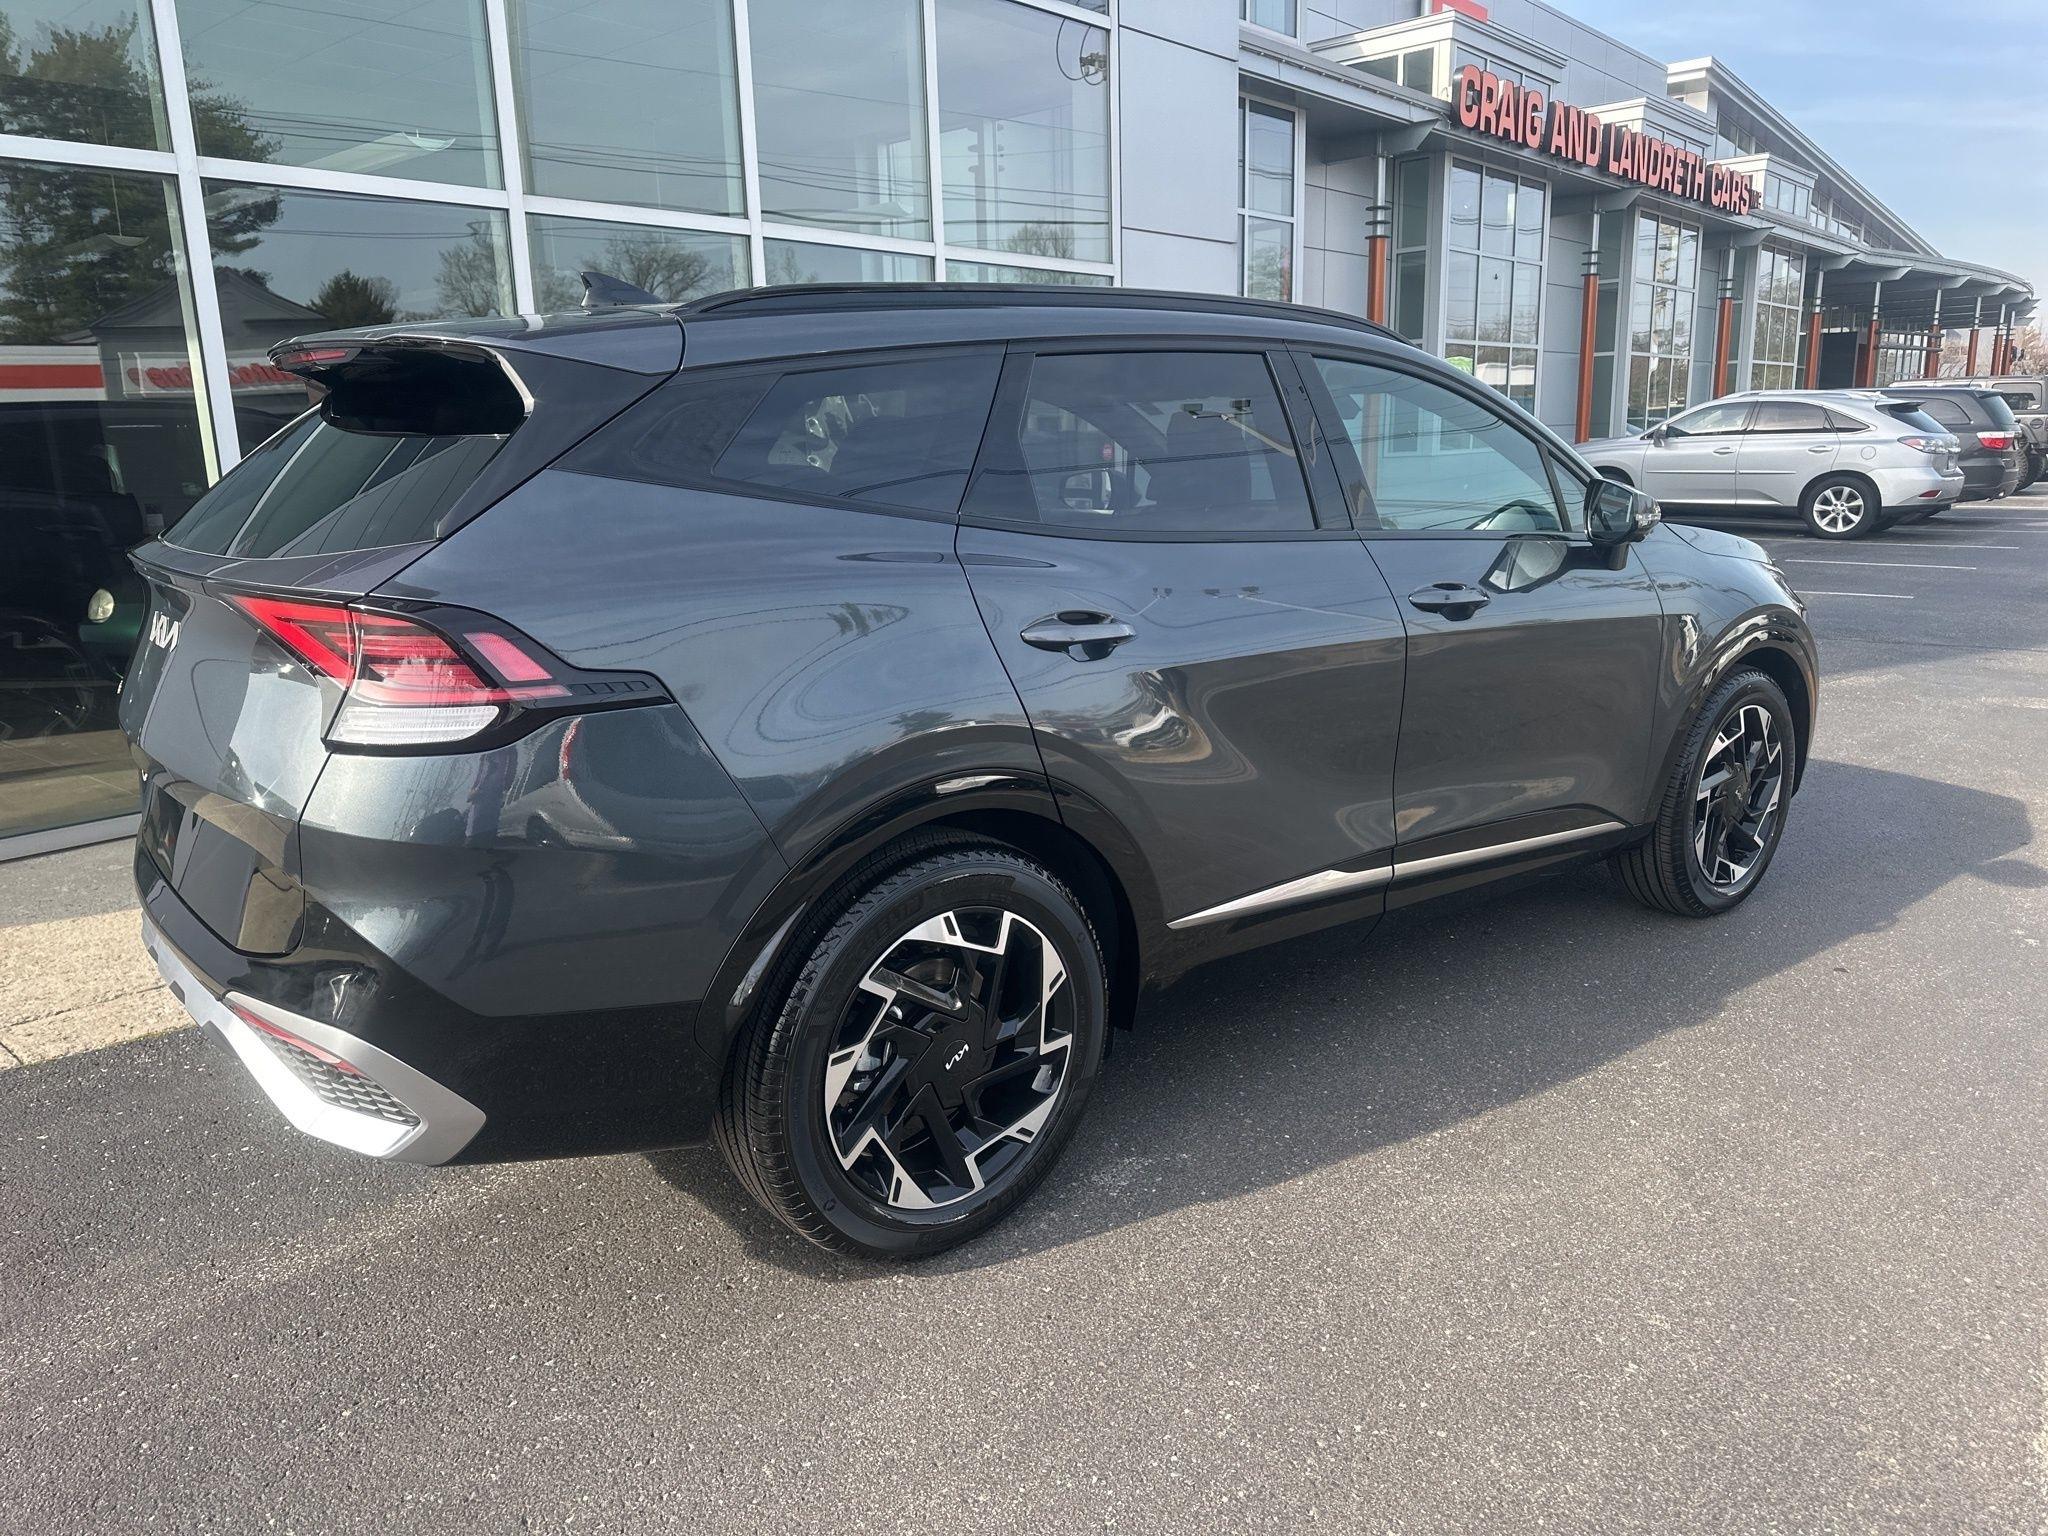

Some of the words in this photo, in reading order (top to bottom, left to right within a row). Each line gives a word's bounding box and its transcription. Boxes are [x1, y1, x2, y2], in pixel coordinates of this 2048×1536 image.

[1459, 64, 1543, 149] CRAIG
[1551, 100, 1601, 167] AND
[1609, 122, 1706, 202] LANDRETH
[1711, 163, 1750, 216] CARS
